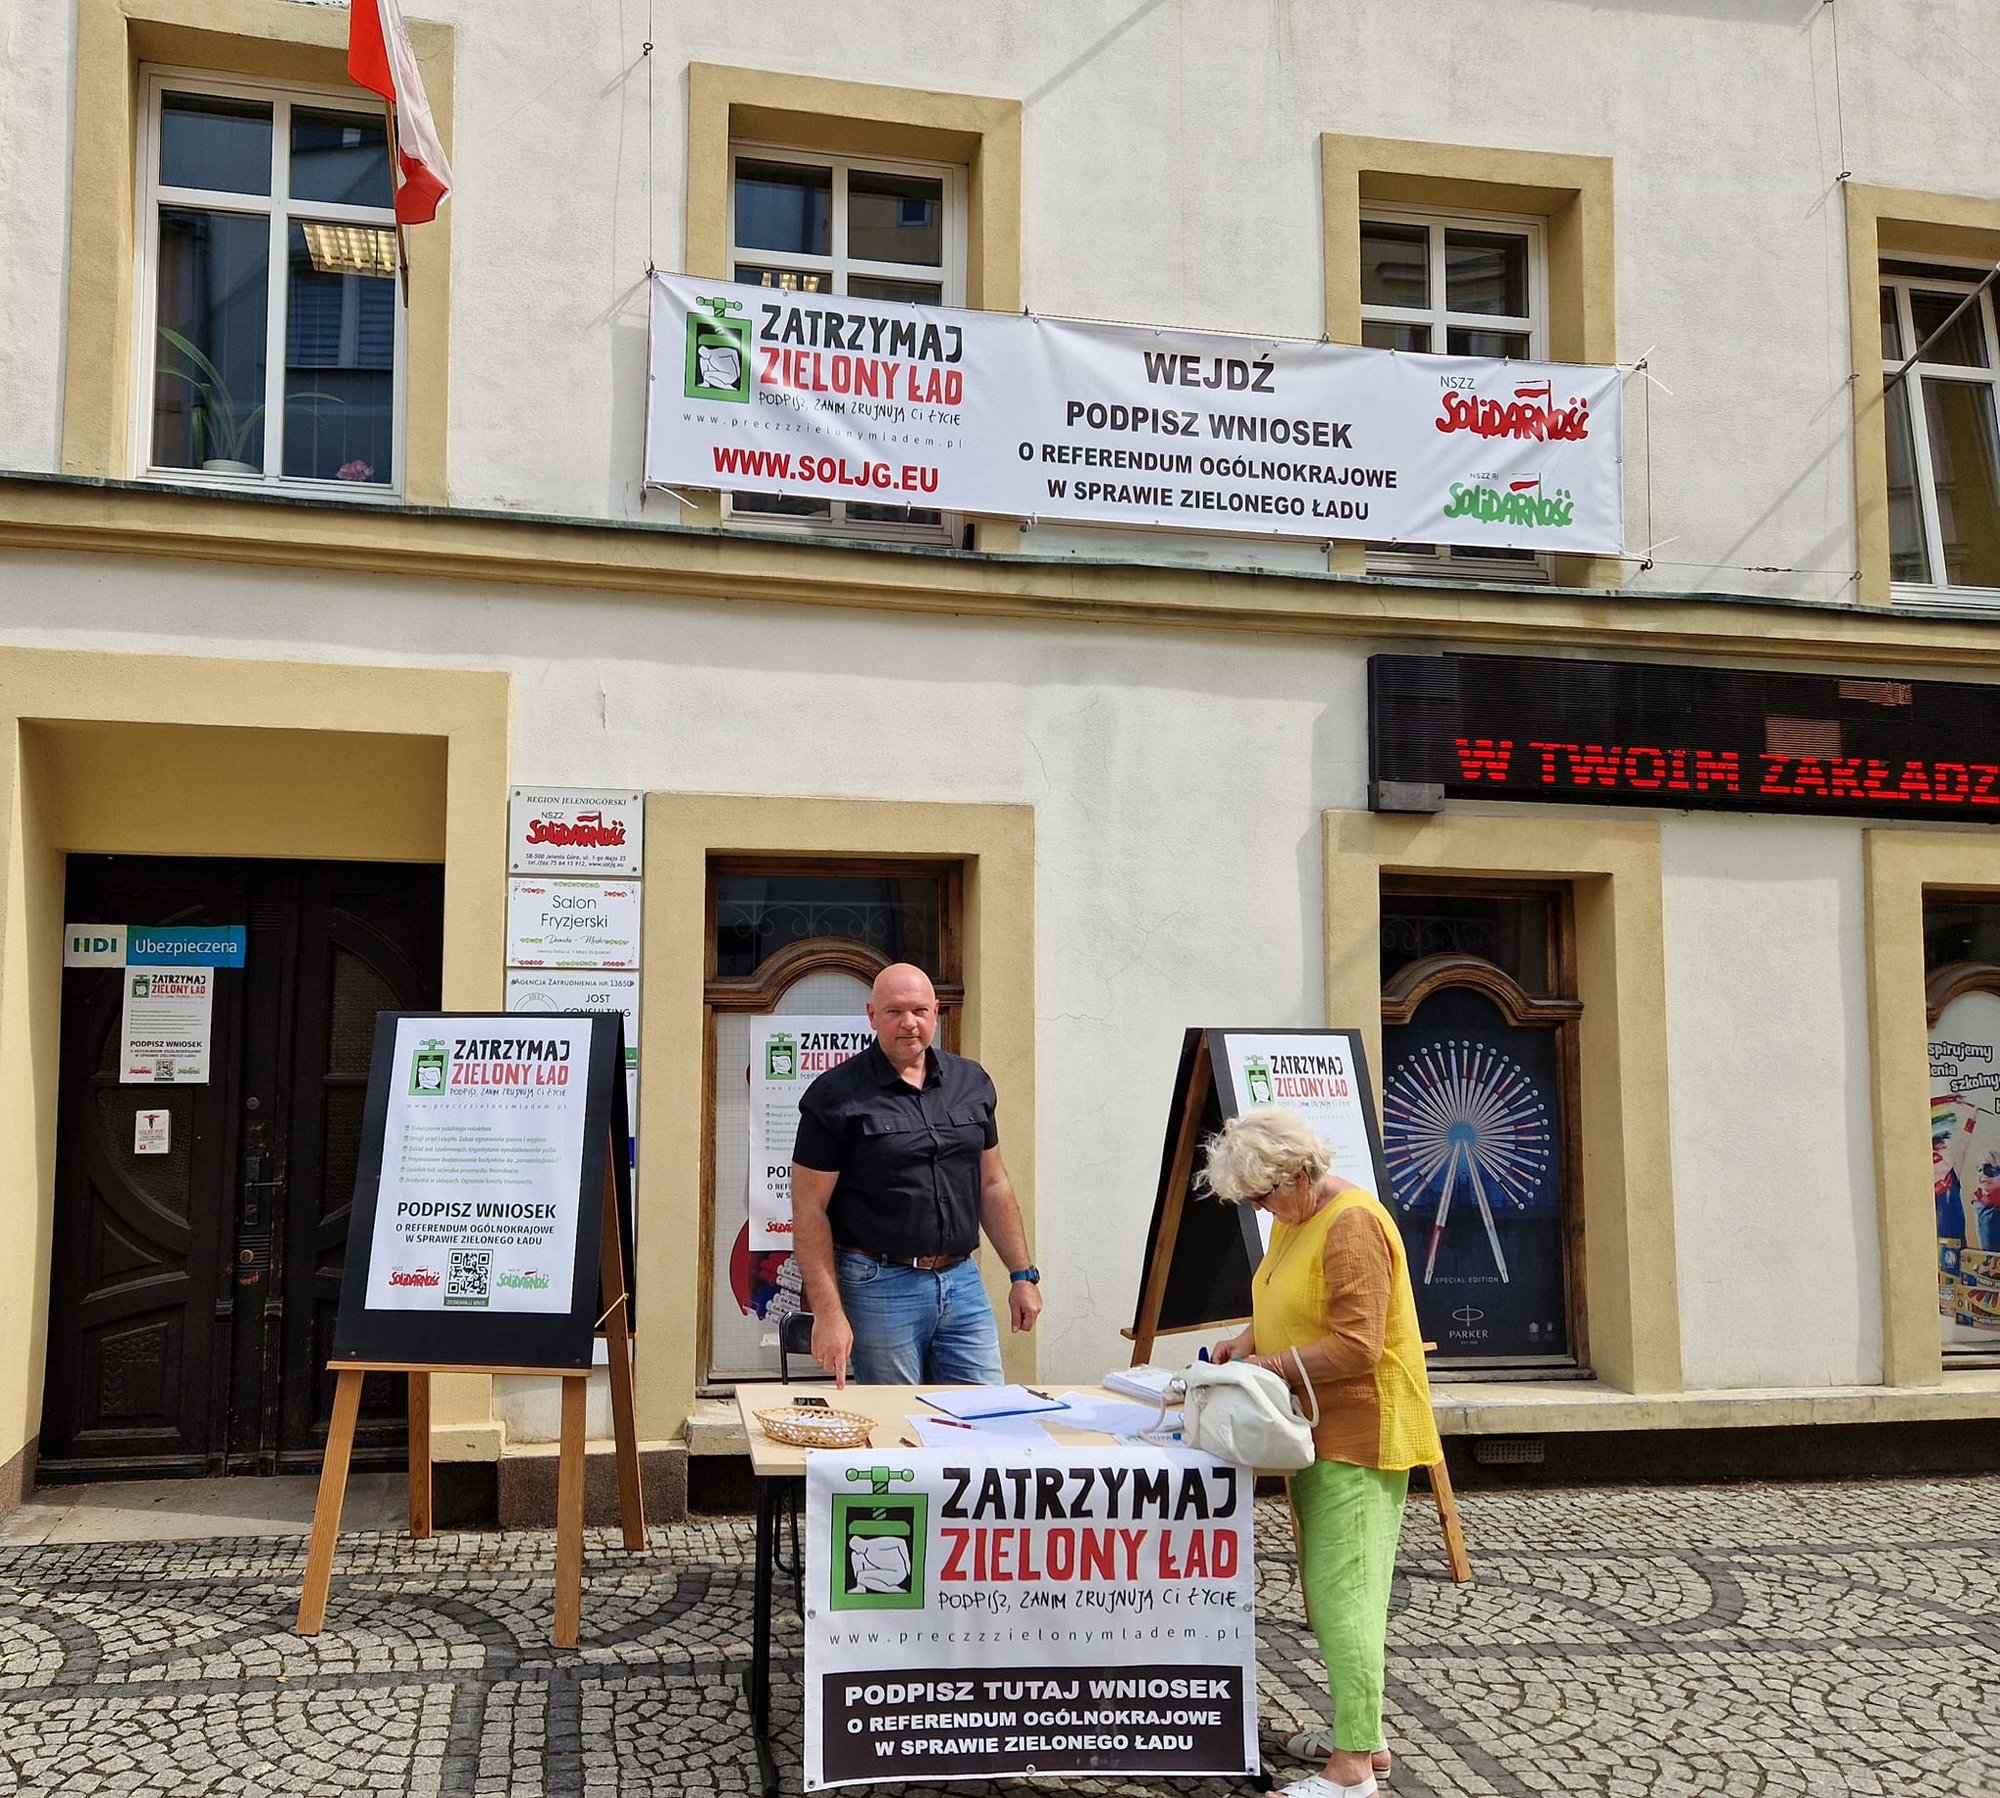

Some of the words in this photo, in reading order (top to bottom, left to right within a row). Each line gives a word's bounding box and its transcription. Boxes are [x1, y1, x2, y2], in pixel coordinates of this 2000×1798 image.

[759, 303, 963, 364] ZATRZYMAJ
[759, 346, 907, 399] ZIELONY
[909, 364, 963, 405] ŁAD
[1143, 351, 1275, 394] WEJDŹ
[1440, 376, 1475, 390] NSZZ
[813, 397, 846, 415] ZANIM
[1066, 400, 1199, 437] PODPISZ
[1208, 413, 1353, 449] WNIOSEK
[713, 445, 939, 493] WWW.SOLJG.EU
[1018, 442, 1033, 462] O
[1042, 443, 1193, 474] REFERENDUM
[1200, 453, 1398, 490] OGÓLNOKRAJOWE
[1047, 479, 1067, 499] W
[1073, 480, 1173, 507] SPRAWIE
[1180, 490, 1304, 516] ZIELONEGO
[1311, 498, 1369, 521] ŁADU
[1455, 738, 1514, 781] W
[526, 796, 559, 804] REGION
[561, 797, 627, 806] JELENIOGÓRSKI
[541, 812, 564, 820] NSZZ
[552, 894, 597, 909] Salon
[540, 913, 609, 930] Fryzjerski
[73, 937, 117, 953] HDI
[151, 974, 206, 985] ZATRZYMAJ
[151, 984, 189, 994] ZIELONY
[190, 985, 206, 995] ŁAD
[586, 994, 611, 1003] JOST
[130, 1040, 165, 1048] PODPISZ
[166, 1040, 202, 1048] WNIOSEK
[453, 1039, 570, 1062] ZATRZYMAJ
[451, 1063, 533, 1085] ZIELONY
[535, 1064, 569, 1086] ŁAD
[1270, 1055, 1344, 1076] ZATRZYMAJ
[1274, 1077, 1325, 1097] ZIELONY
[1328, 1078, 1349, 1098] ŁAD
[397, 1202, 471, 1218] PODPISZ
[476, 1203, 557, 1219] WNIOSEK
[395, 1223, 403, 1232] O
[405, 1223, 468, 1233] REFERENDUM
[469, 1222, 555, 1234] OGÓLNOKRAJOWE
[405, 1235, 415, 1243] W
[416, 1235, 458, 1244] SPRAWIE
[460, 1235, 514, 1245] ZIELONEGO
[516, 1236, 543, 1246] ŁADU
[1468, 1276, 1499, 1284] EDITION
[1449, 1329, 1489, 1339] PARKER
[941, 1466, 1238, 1521] ZATRZYMAJ
[940, 1528, 1149, 1582] ZIELONY
[1158, 1528, 1239, 1580] ŁAD
[1019, 1590, 1067, 1610] ZANIM
[1075, 1590, 1154, 1615] ZRUJNUJĄ
[1187, 1589, 1237, 1609] ŻYCIE
[845, 1681, 975, 1707] PODPISZ
[983, 1680, 1080, 1701] TUTAJ
[1089, 1678, 1231, 1700] WNIOSEK
[847, 1718, 862, 1734] O
[869, 1711, 1017, 1732] REFERENDUM
[1023, 1708, 1222, 1727] OGÓLNOKRAJOWE
[875, 1740, 894, 1757] W
[900, 1737, 999, 1756] SPRAWIE
[1004, 1735, 1128, 1752] ZIELONEGO
[1134, 1734, 1194, 1751] ŁADU
